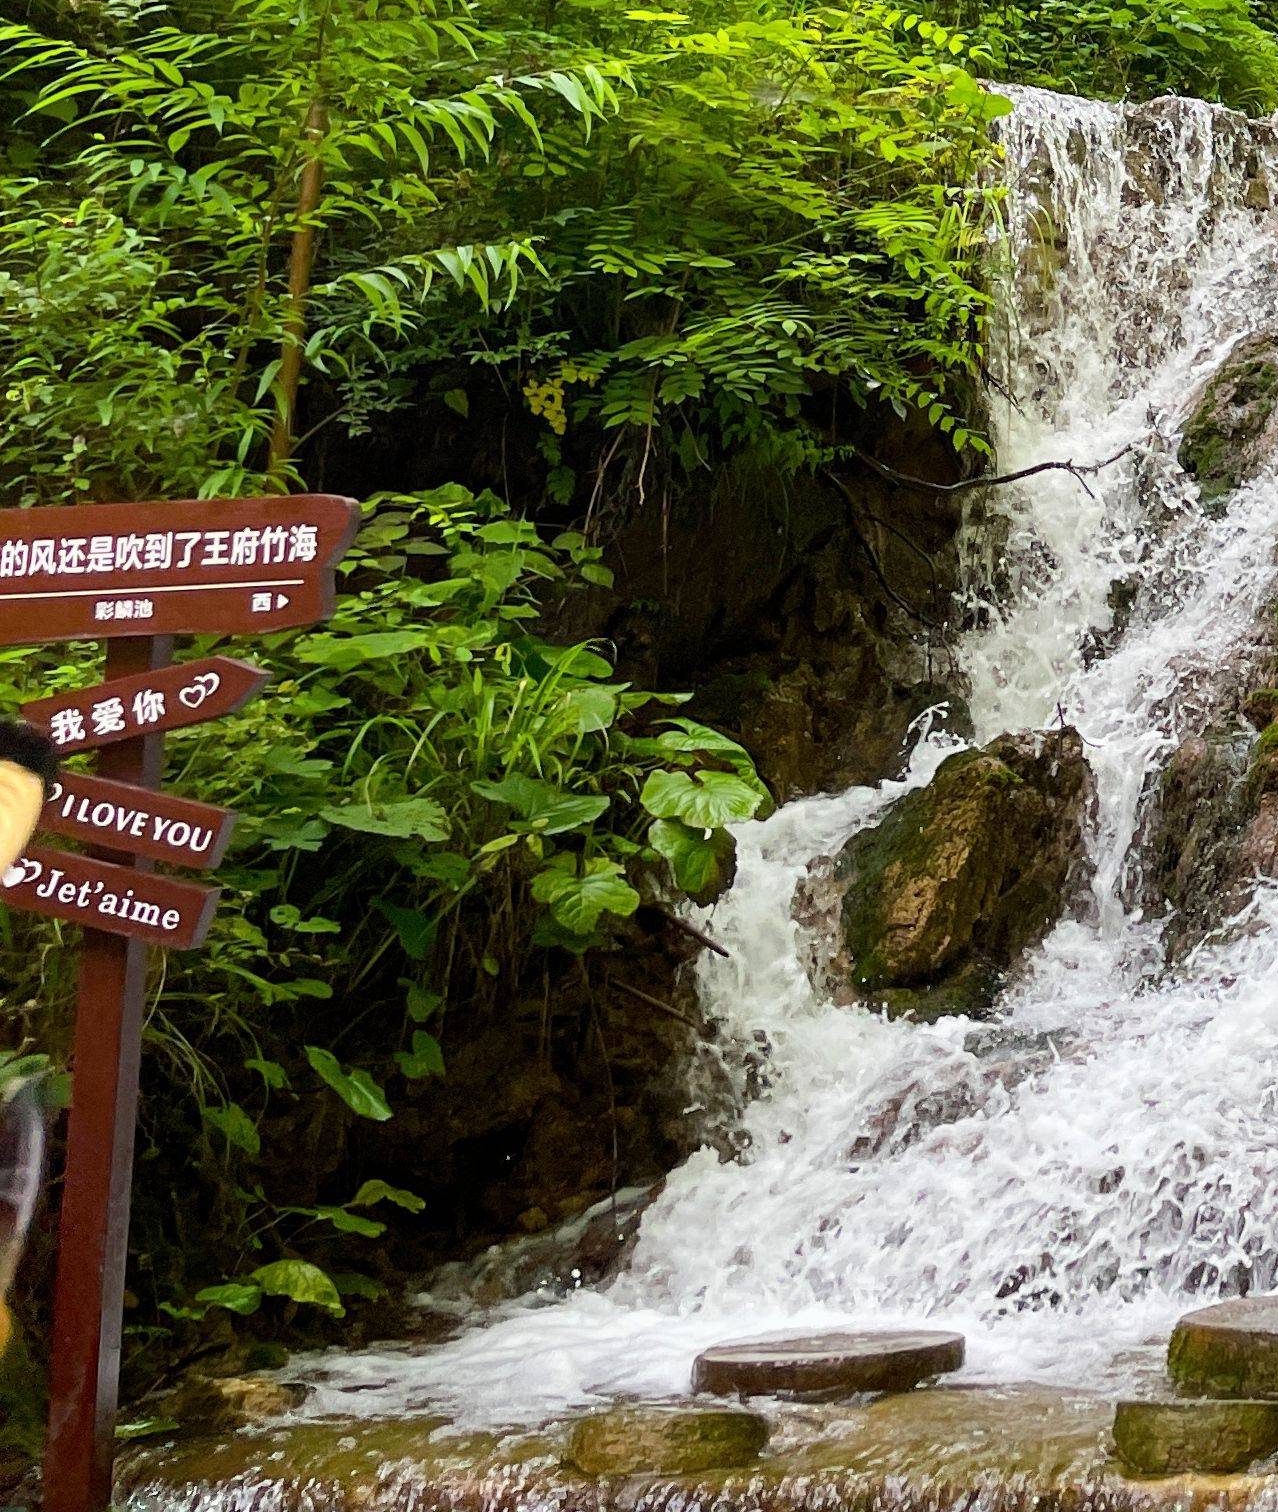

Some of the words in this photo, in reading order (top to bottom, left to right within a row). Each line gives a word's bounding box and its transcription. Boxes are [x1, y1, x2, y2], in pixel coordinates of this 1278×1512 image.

[0, 523, 318, 578] 的风还是吹到了王府竹海
[252, 592, 273, 612] 西
[61, 794, 75, 818] I
[76, 798, 149, 837] LOVE
[152, 816, 213, 852] YOU
